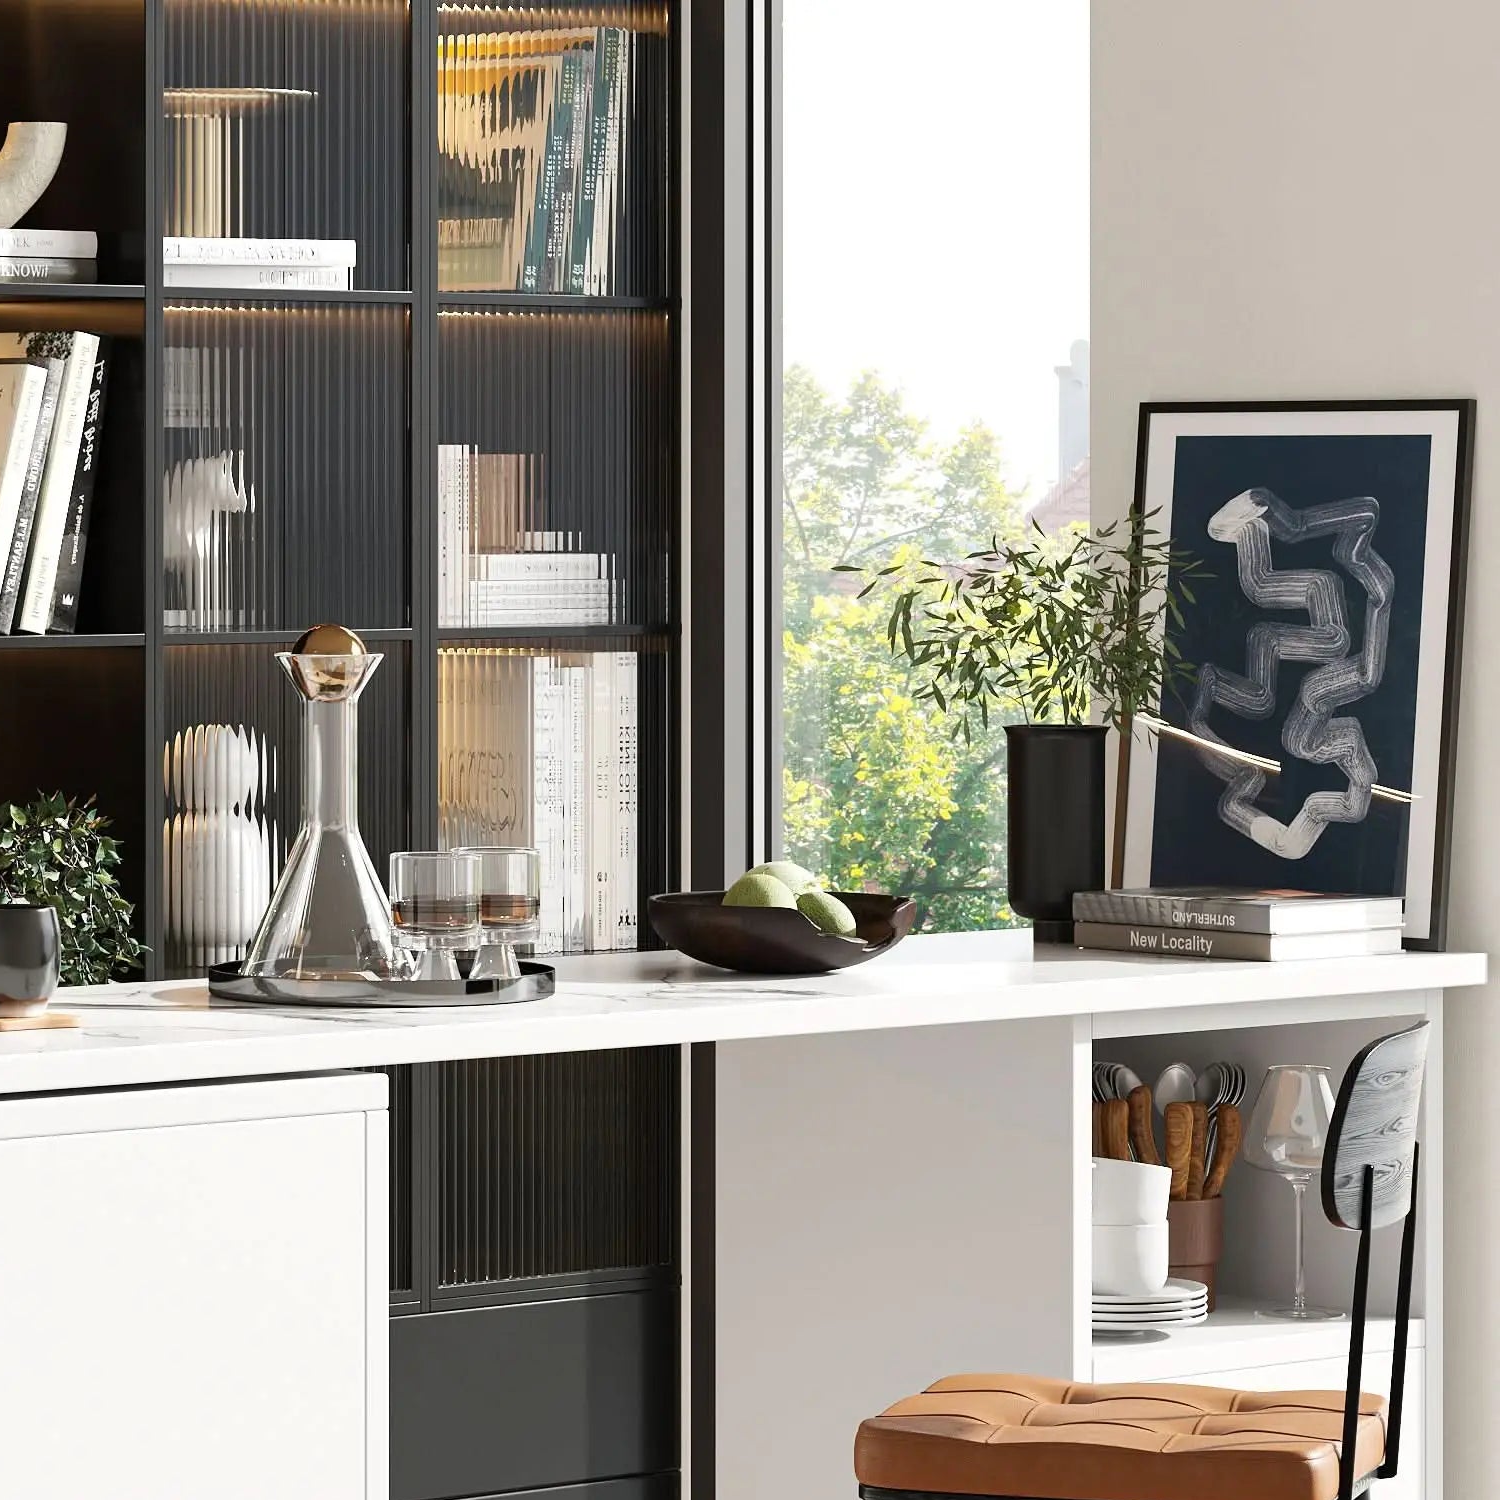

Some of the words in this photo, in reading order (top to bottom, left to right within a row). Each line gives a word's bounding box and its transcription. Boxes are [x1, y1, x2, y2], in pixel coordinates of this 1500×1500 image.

[1172, 911, 1236, 926] SUTHERLAND
[1129, 930, 1158, 948] New
[1161, 933, 1213, 955] Locality
